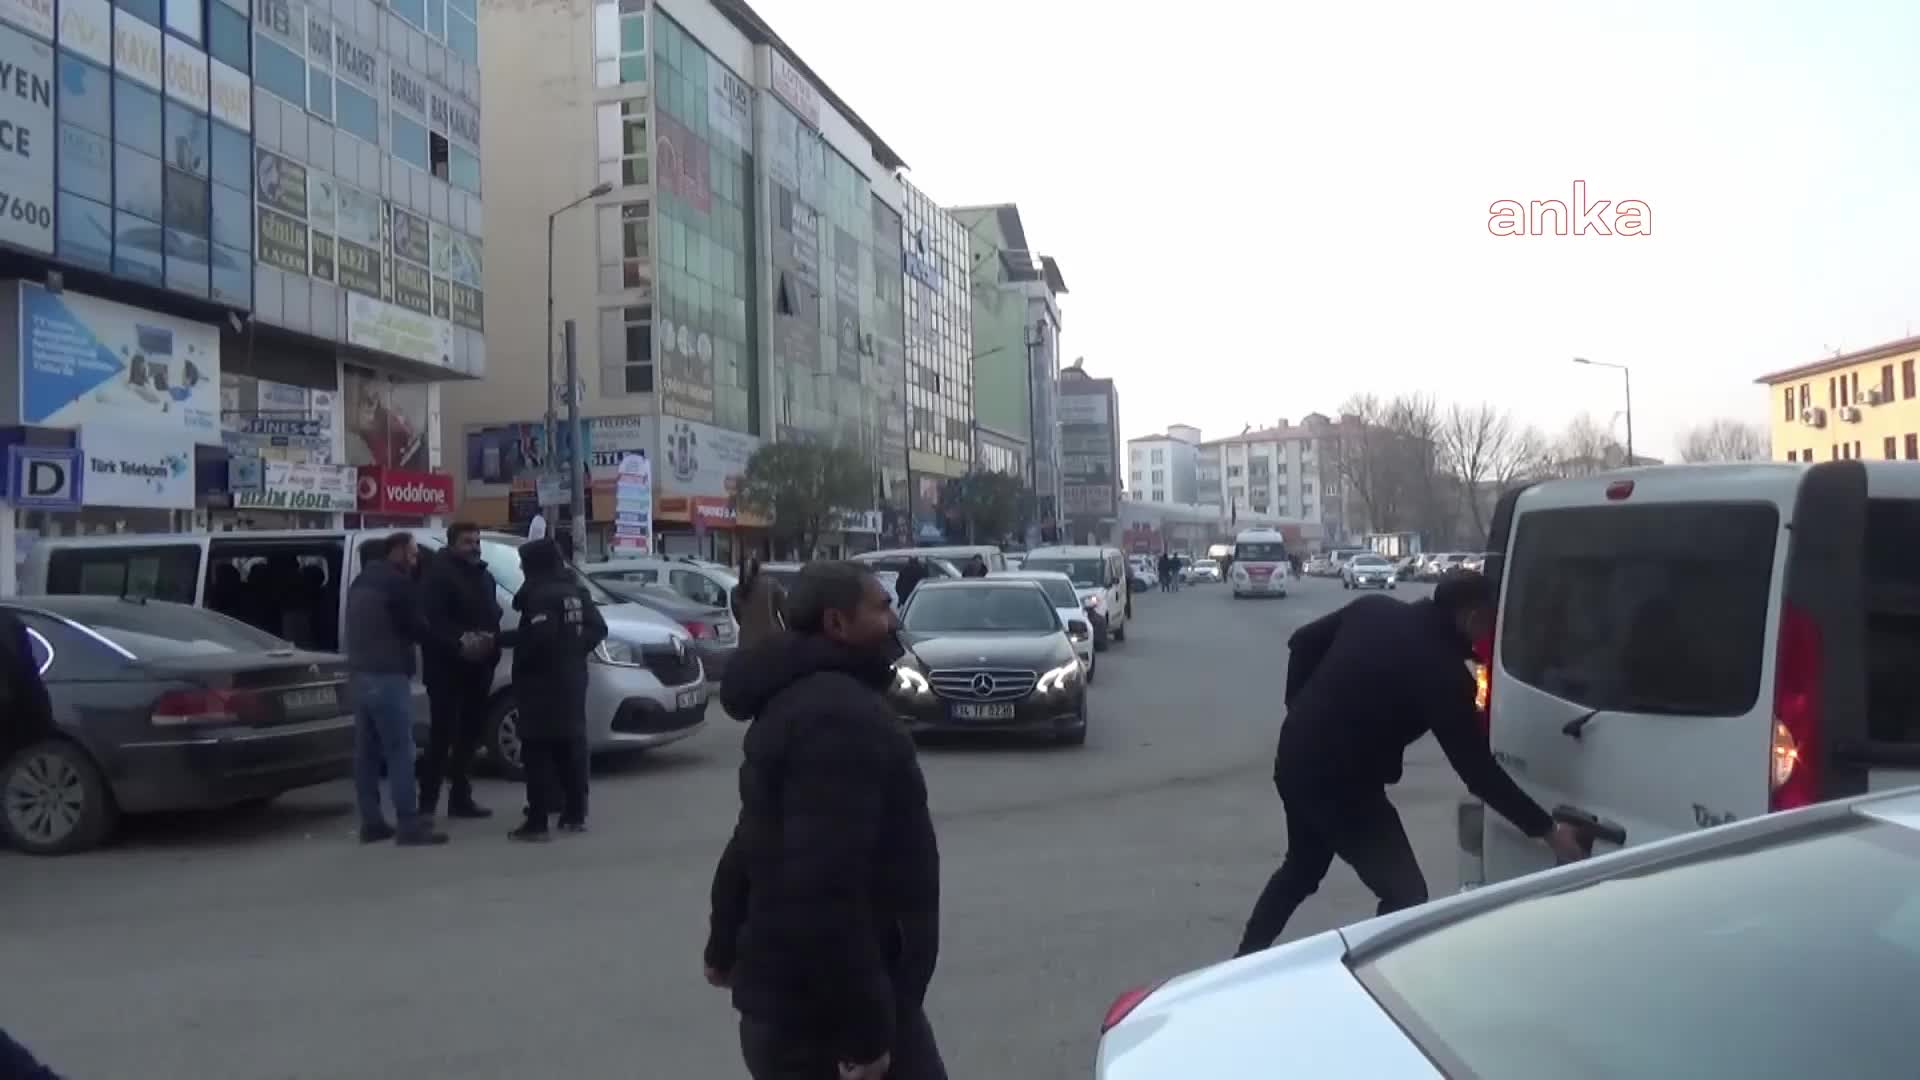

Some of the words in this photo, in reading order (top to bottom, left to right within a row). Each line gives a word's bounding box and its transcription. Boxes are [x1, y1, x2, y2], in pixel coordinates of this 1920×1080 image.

[28, 461, 65, 496] D
[90, 458, 117, 473] Türk
[121, 459, 168, 479] Telekom
[386, 482, 445, 503] vodafone
